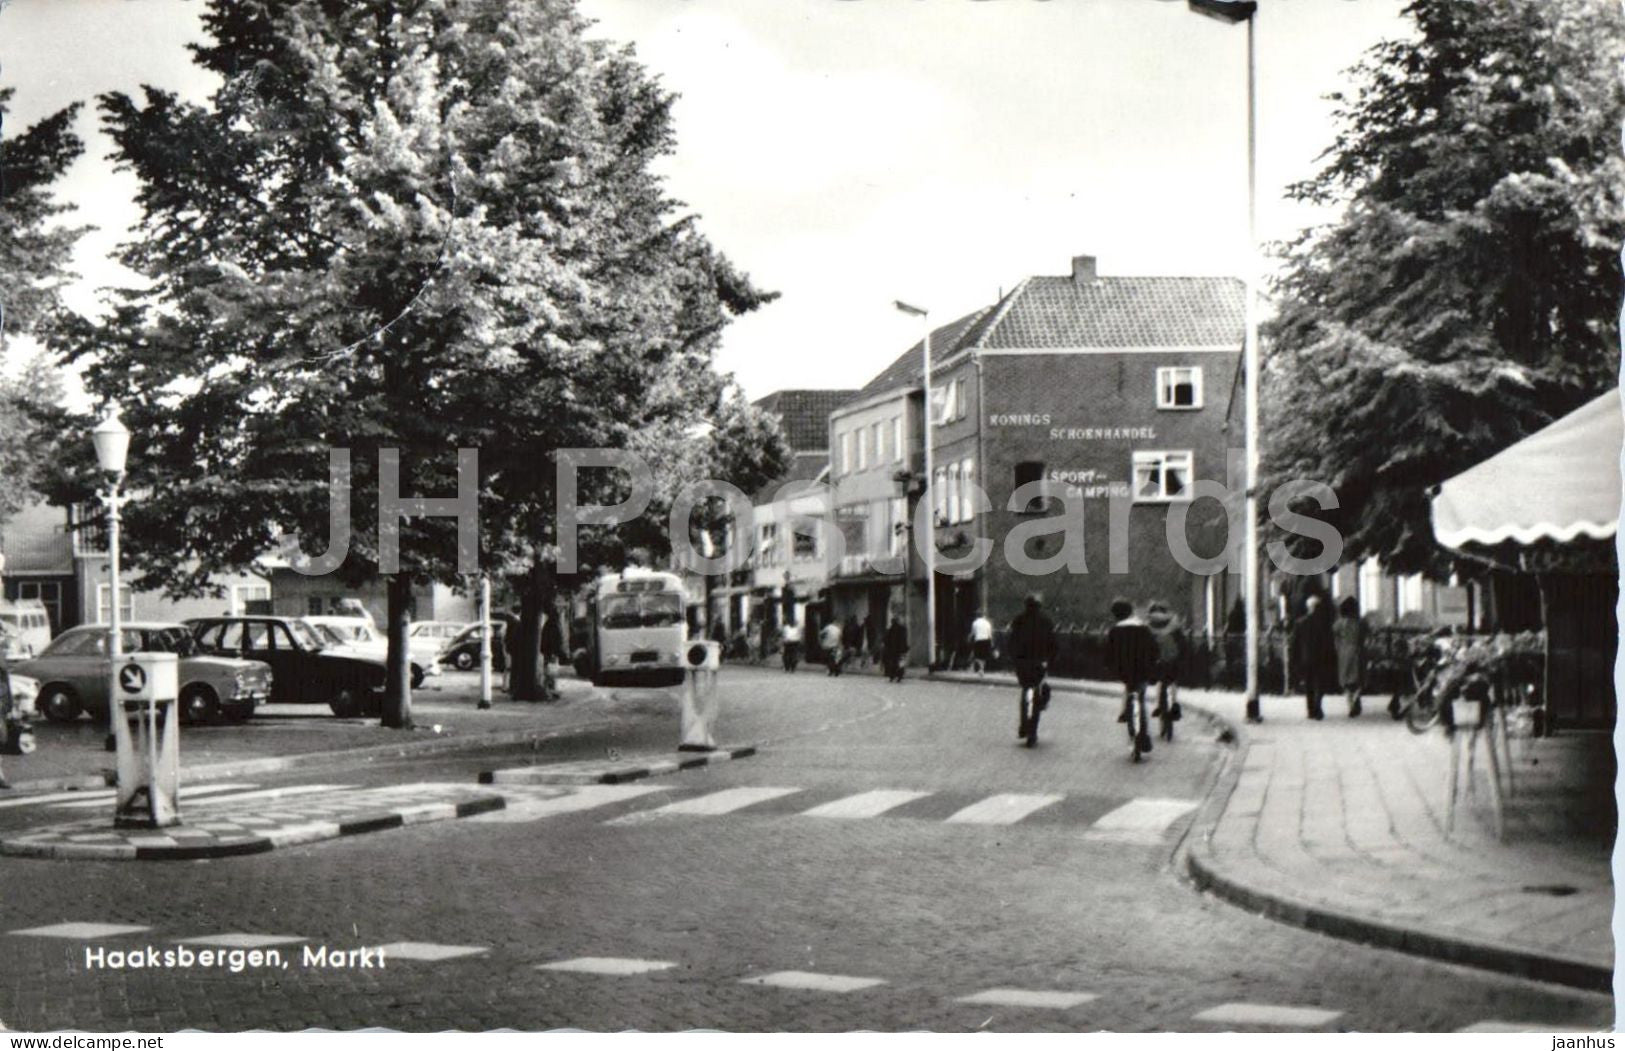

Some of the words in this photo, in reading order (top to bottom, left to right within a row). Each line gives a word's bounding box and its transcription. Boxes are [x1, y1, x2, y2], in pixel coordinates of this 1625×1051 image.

[990, 414, 1051, 426] KONINGS
[1050, 428, 1156, 440] SCHOENHANDEL
[1066, 486, 1129, 498] CAMPING
